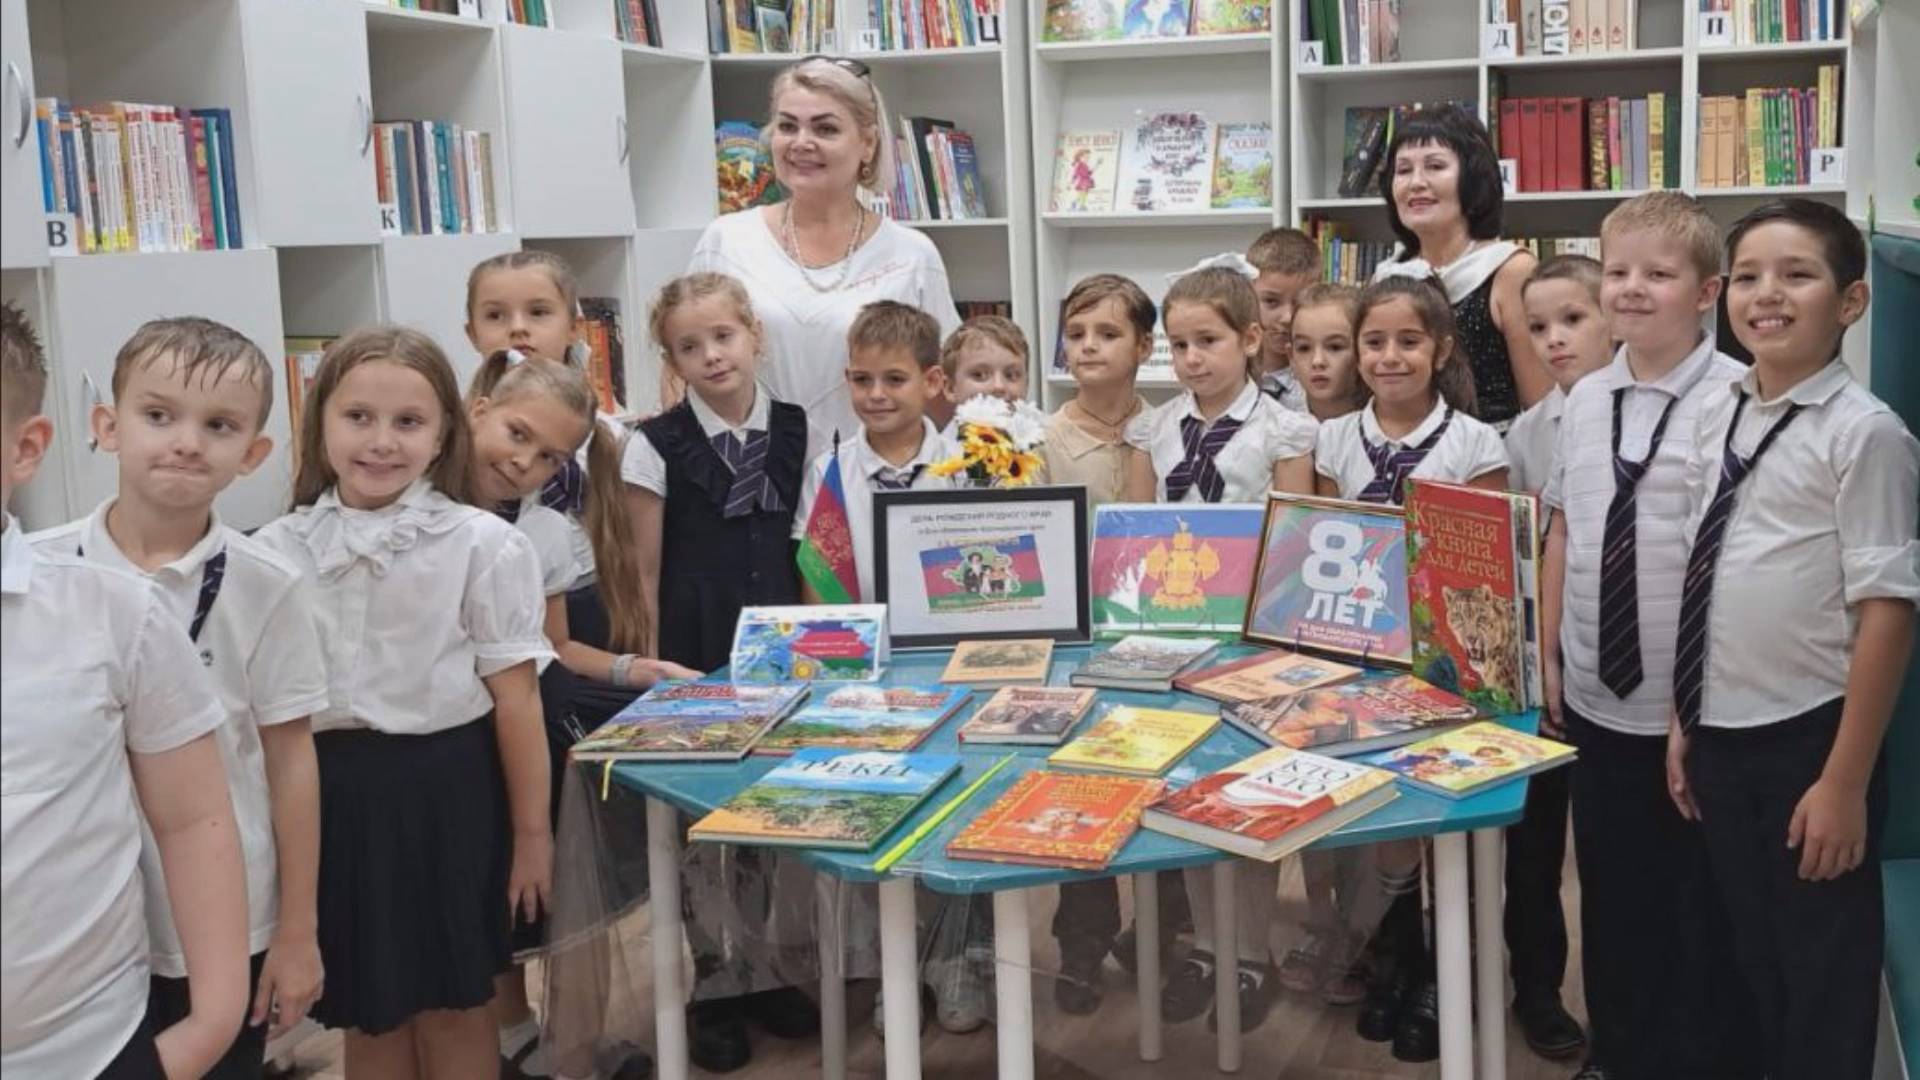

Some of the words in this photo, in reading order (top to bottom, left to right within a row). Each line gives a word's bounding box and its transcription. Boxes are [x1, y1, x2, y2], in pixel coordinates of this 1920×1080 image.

[1706, 15, 1724, 35] П
[863, 32, 875, 49] Ч
[1493, 29, 1511, 49] Д
[1303, 46, 1317, 63] А
[1820, 154, 1835, 172] Р
[381, 208, 395, 230] К
[46, 220, 68, 248] В
[1413, 499, 1499, 544] Красная
[1437, 530, 1494, 561] книга
[1458, 556, 1507, 582] детей
[1305, 591, 1384, 629] ЛЕТ
[802, 760, 914, 777] РЕКИ
[1281, 759, 1350, 781] КТО
[1256, 771, 1327, 794] КТО
